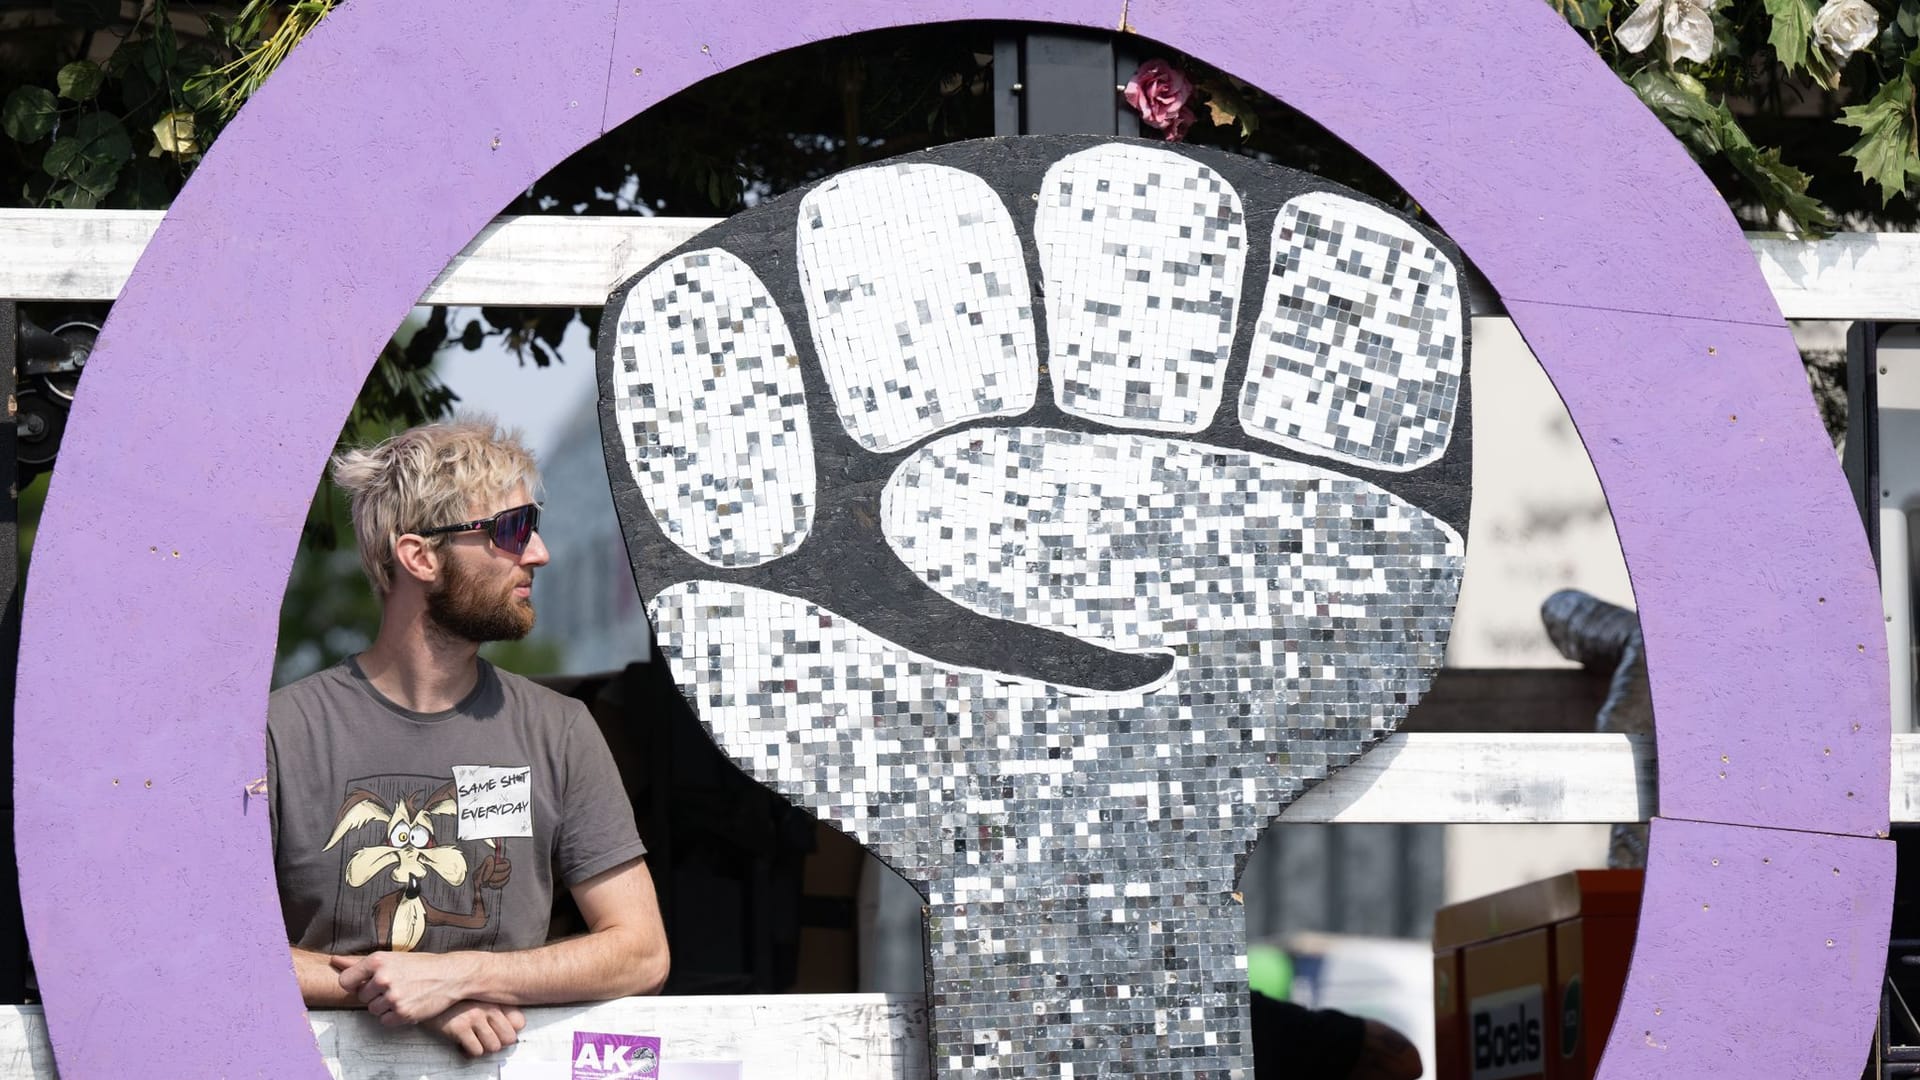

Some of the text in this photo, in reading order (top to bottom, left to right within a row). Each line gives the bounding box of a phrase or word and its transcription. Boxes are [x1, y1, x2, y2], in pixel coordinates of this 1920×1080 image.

[459, 779, 496, 797] SAME
[461, 801, 529, 820] EVERYDAY
[1474, 1003, 1541, 1070] Boels
[574, 1043, 632, 1071] AK
